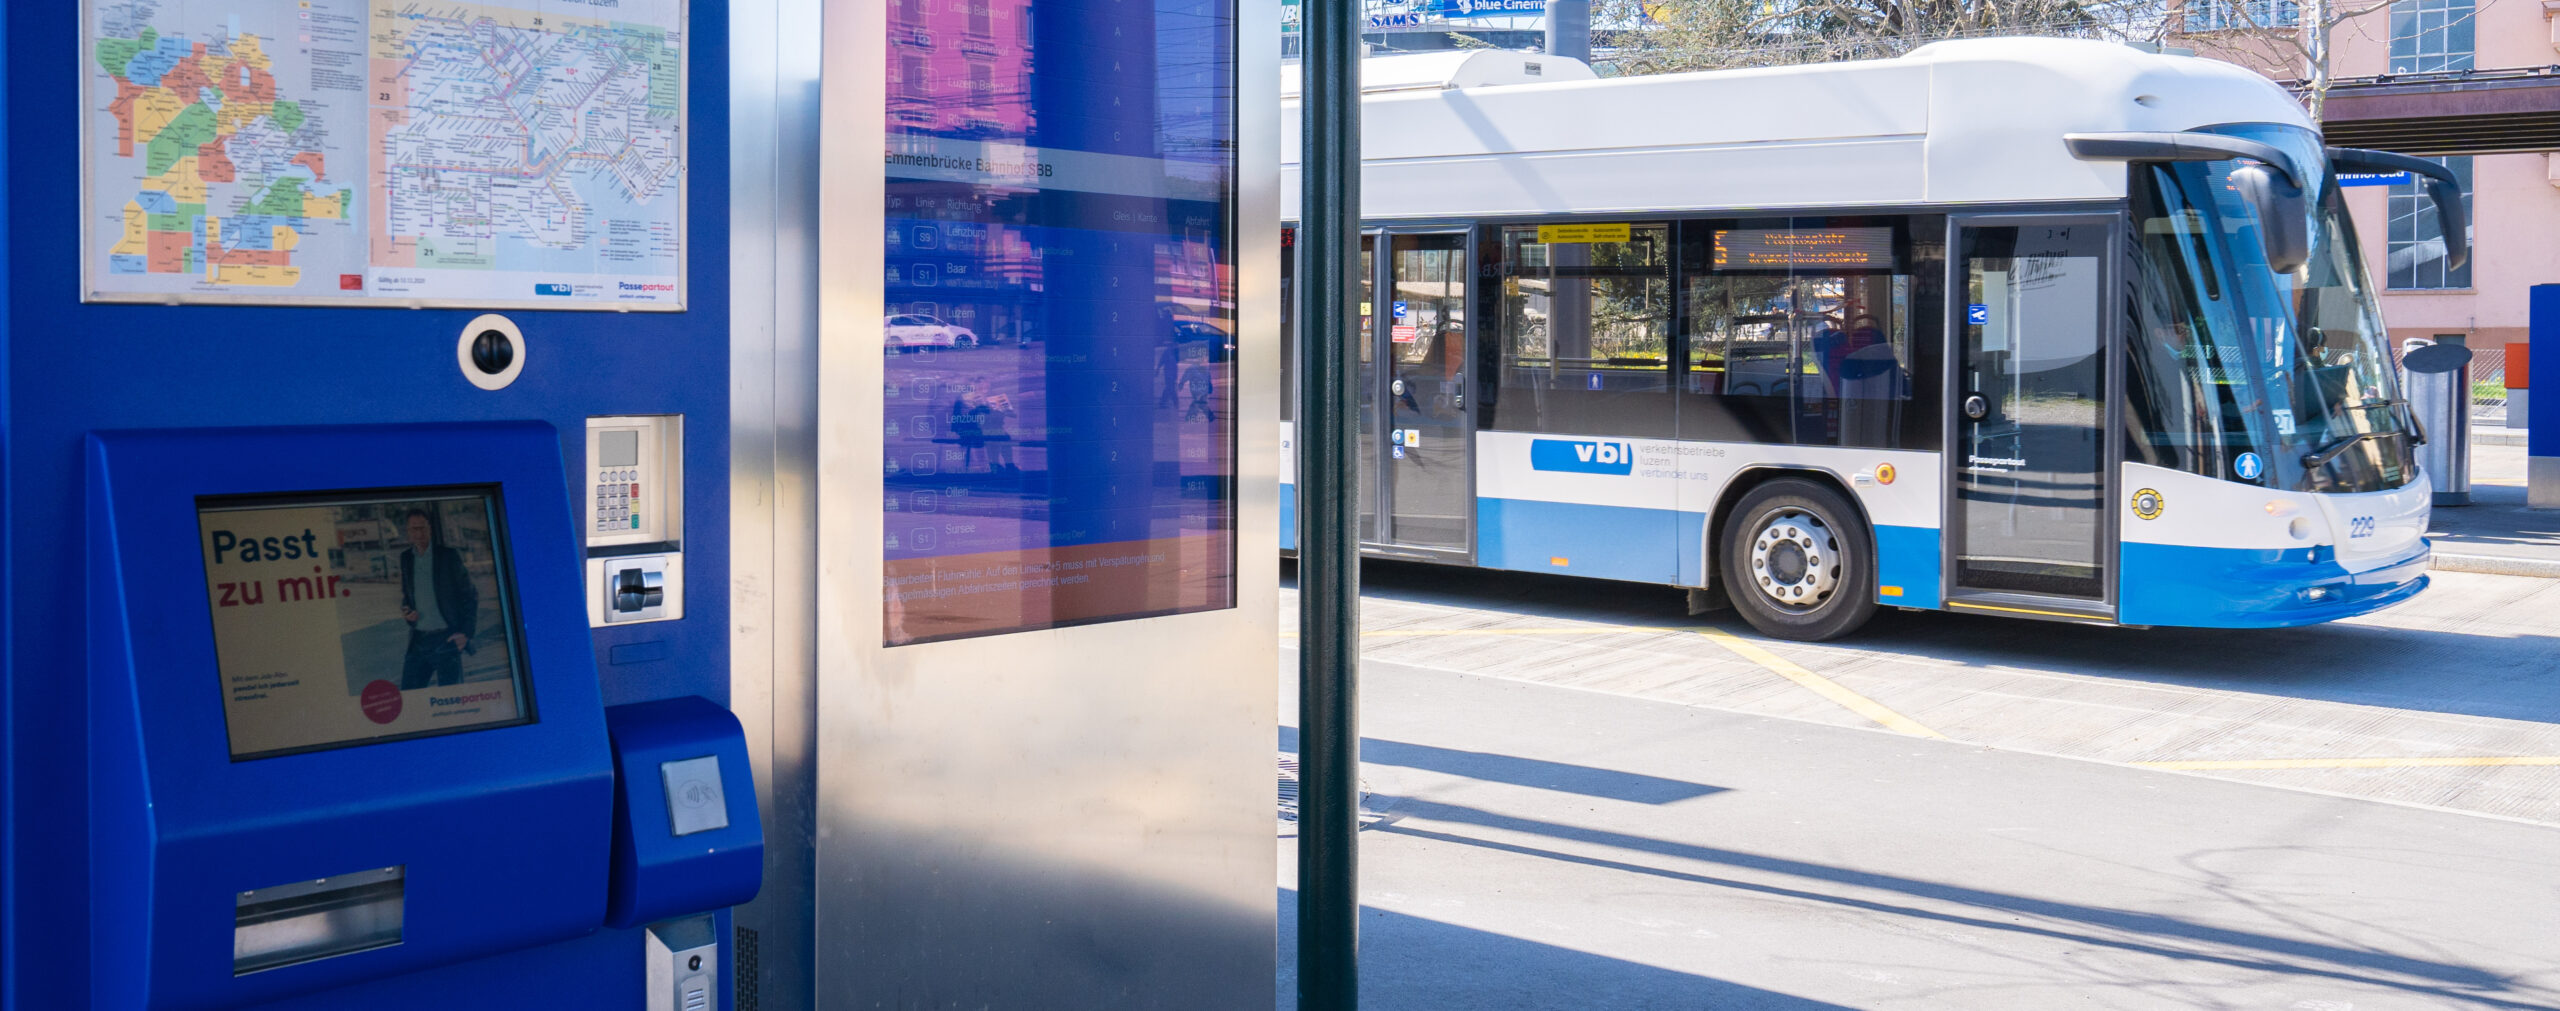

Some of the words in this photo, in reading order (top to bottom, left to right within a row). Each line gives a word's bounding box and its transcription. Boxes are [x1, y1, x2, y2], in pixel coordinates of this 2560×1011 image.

[974, 4, 1009, 20] Bahnhof
[1474, 0, 1500, 11] blue
[533, 18, 543, 26] 26
[1114, 26, 1121, 37] A
[1114, 61, 1121, 72] A
[947, 77, 977, 90] Luzern
[979, 80, 1015, 93] Bahnhof
[379, 92, 390, 101] 23
[1113, 96, 1120, 107] A
[1114, 131, 1120, 142] C
[885, 151, 973, 170] Emmenbrücke
[976, 158, 1025, 175] Bahnhof
[1028, 163, 1053, 177] SBB
[915, 198, 935, 208] Linie
[947, 200, 982, 213] Richtung
[919, 232, 931, 242] S9
[947, 225, 986, 240] Lenzburg
[423, 248, 434, 257] 21
[919, 270, 930, 280] S1
[946, 263, 968, 274] Baar
[1112, 277, 1119, 288] 2
[618, 281, 674, 292] Passepartout
[946, 307, 976, 318] Luzern
[1112, 311, 1119, 322] 2
[918, 384, 930, 394] S9
[946, 383, 975, 393] Luzern
[1111, 381, 1118, 392] 2
[946, 413, 985, 424] Lenzburg
[946, 450, 966, 461] Baar
[1111, 451, 1118, 461] 2
[1574, 439, 1629, 465] vbl
[1640, 444, 1725, 458] verkehrsbetriebe
[1640, 456, 1671, 467] luzern
[1640, 469, 1688, 480] verbindet
[1690, 472, 1709, 481] uns
[918, 535, 930, 544] S1
[945, 524, 976, 536] Sursee
[2350, 516, 2375, 539] 229
[211, 528, 319, 565] Passt
[986, 567, 1000, 577] Auf
[1004, 566, 1018, 576] den
[1063, 560, 1083, 570] muss
[1086, 558, 1097, 569] mit
[217, 579, 264, 607] zu
[277, 565, 351, 603] mir.
[1019, 578, 1059, 592] gerechnet
[430, 690, 502, 707] Passepartout
